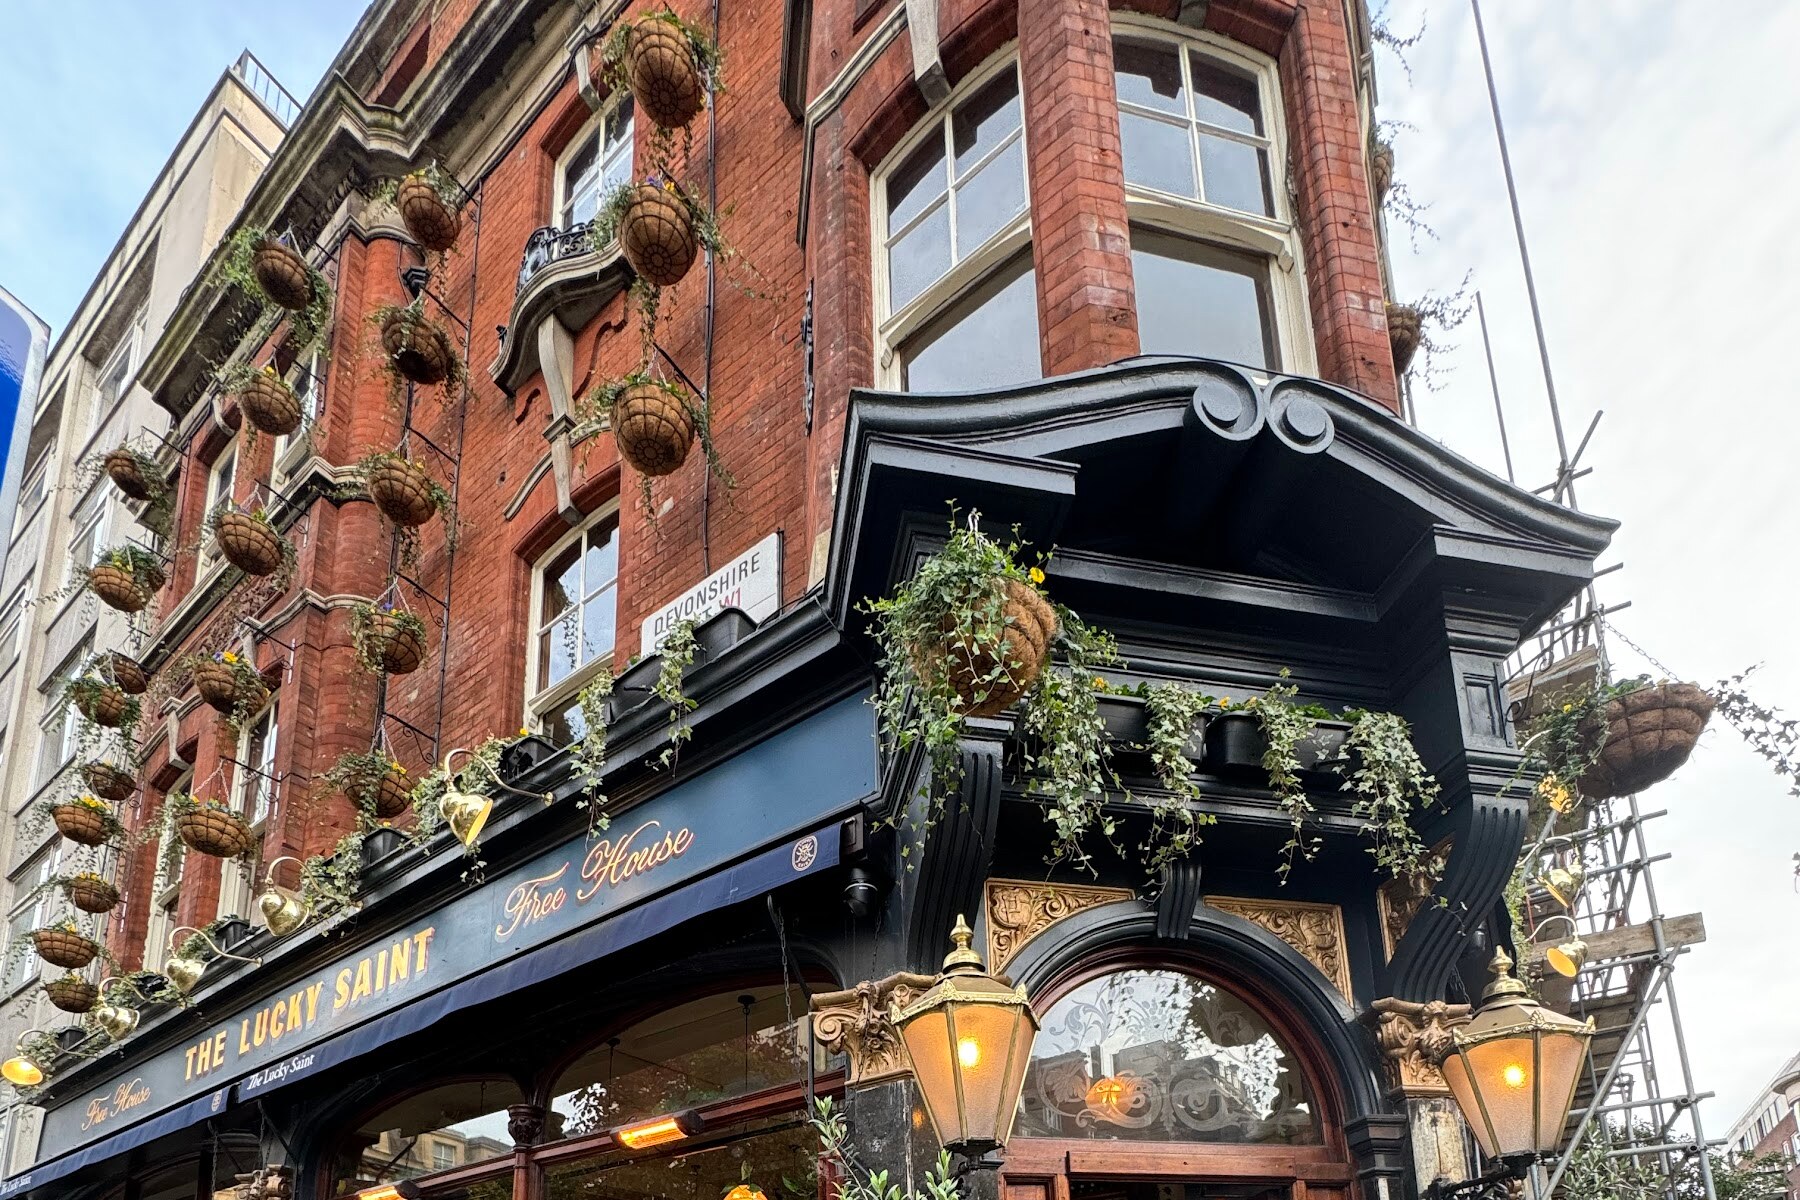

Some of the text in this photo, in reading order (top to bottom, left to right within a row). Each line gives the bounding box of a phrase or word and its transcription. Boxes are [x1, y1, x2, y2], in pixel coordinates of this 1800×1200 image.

[654, 551, 760, 637] DEVONSHIRE
[495, 820, 695, 938] Free House
[184, 926, 435, 1081] THE LUCKY SAINT
[81, 1077, 151, 1131] Free House
[246, 1054, 315, 1090] The Lucky Saint
